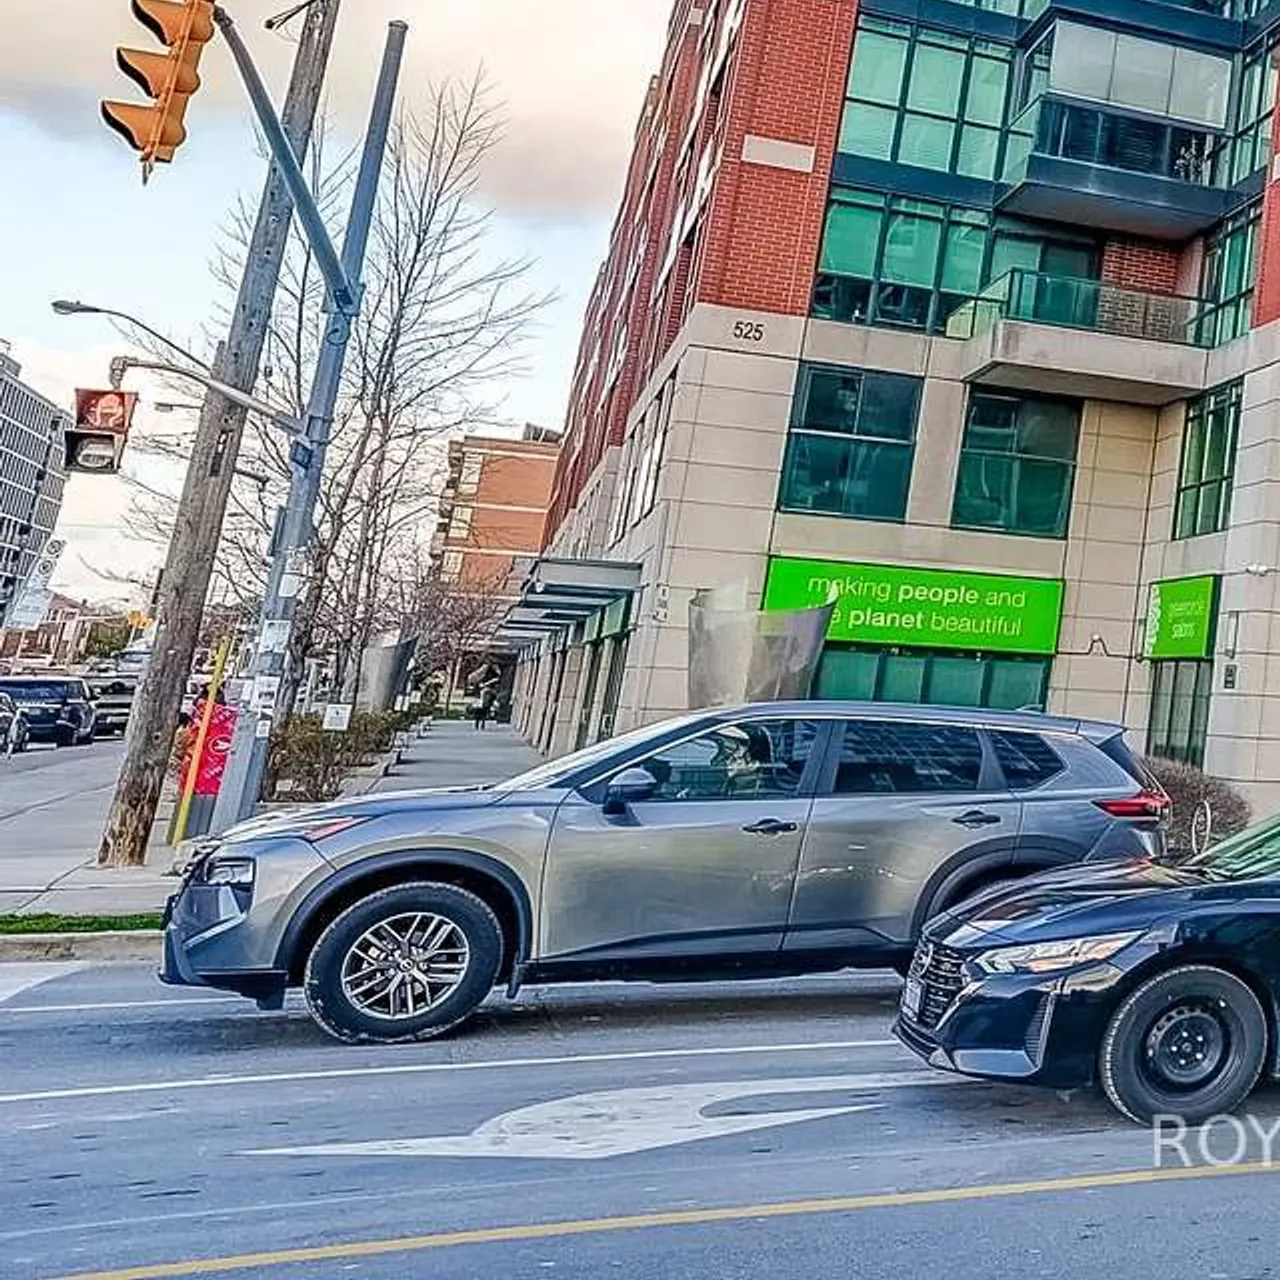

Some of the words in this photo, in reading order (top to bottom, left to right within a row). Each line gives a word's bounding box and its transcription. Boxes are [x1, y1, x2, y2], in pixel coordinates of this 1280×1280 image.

[733, 321, 764, 341] 525
[897, 583, 979, 606] people
[984, 590, 1026, 608] and
[848, 607, 925, 630] planet
[930, 612, 1023, 637] beautiful
